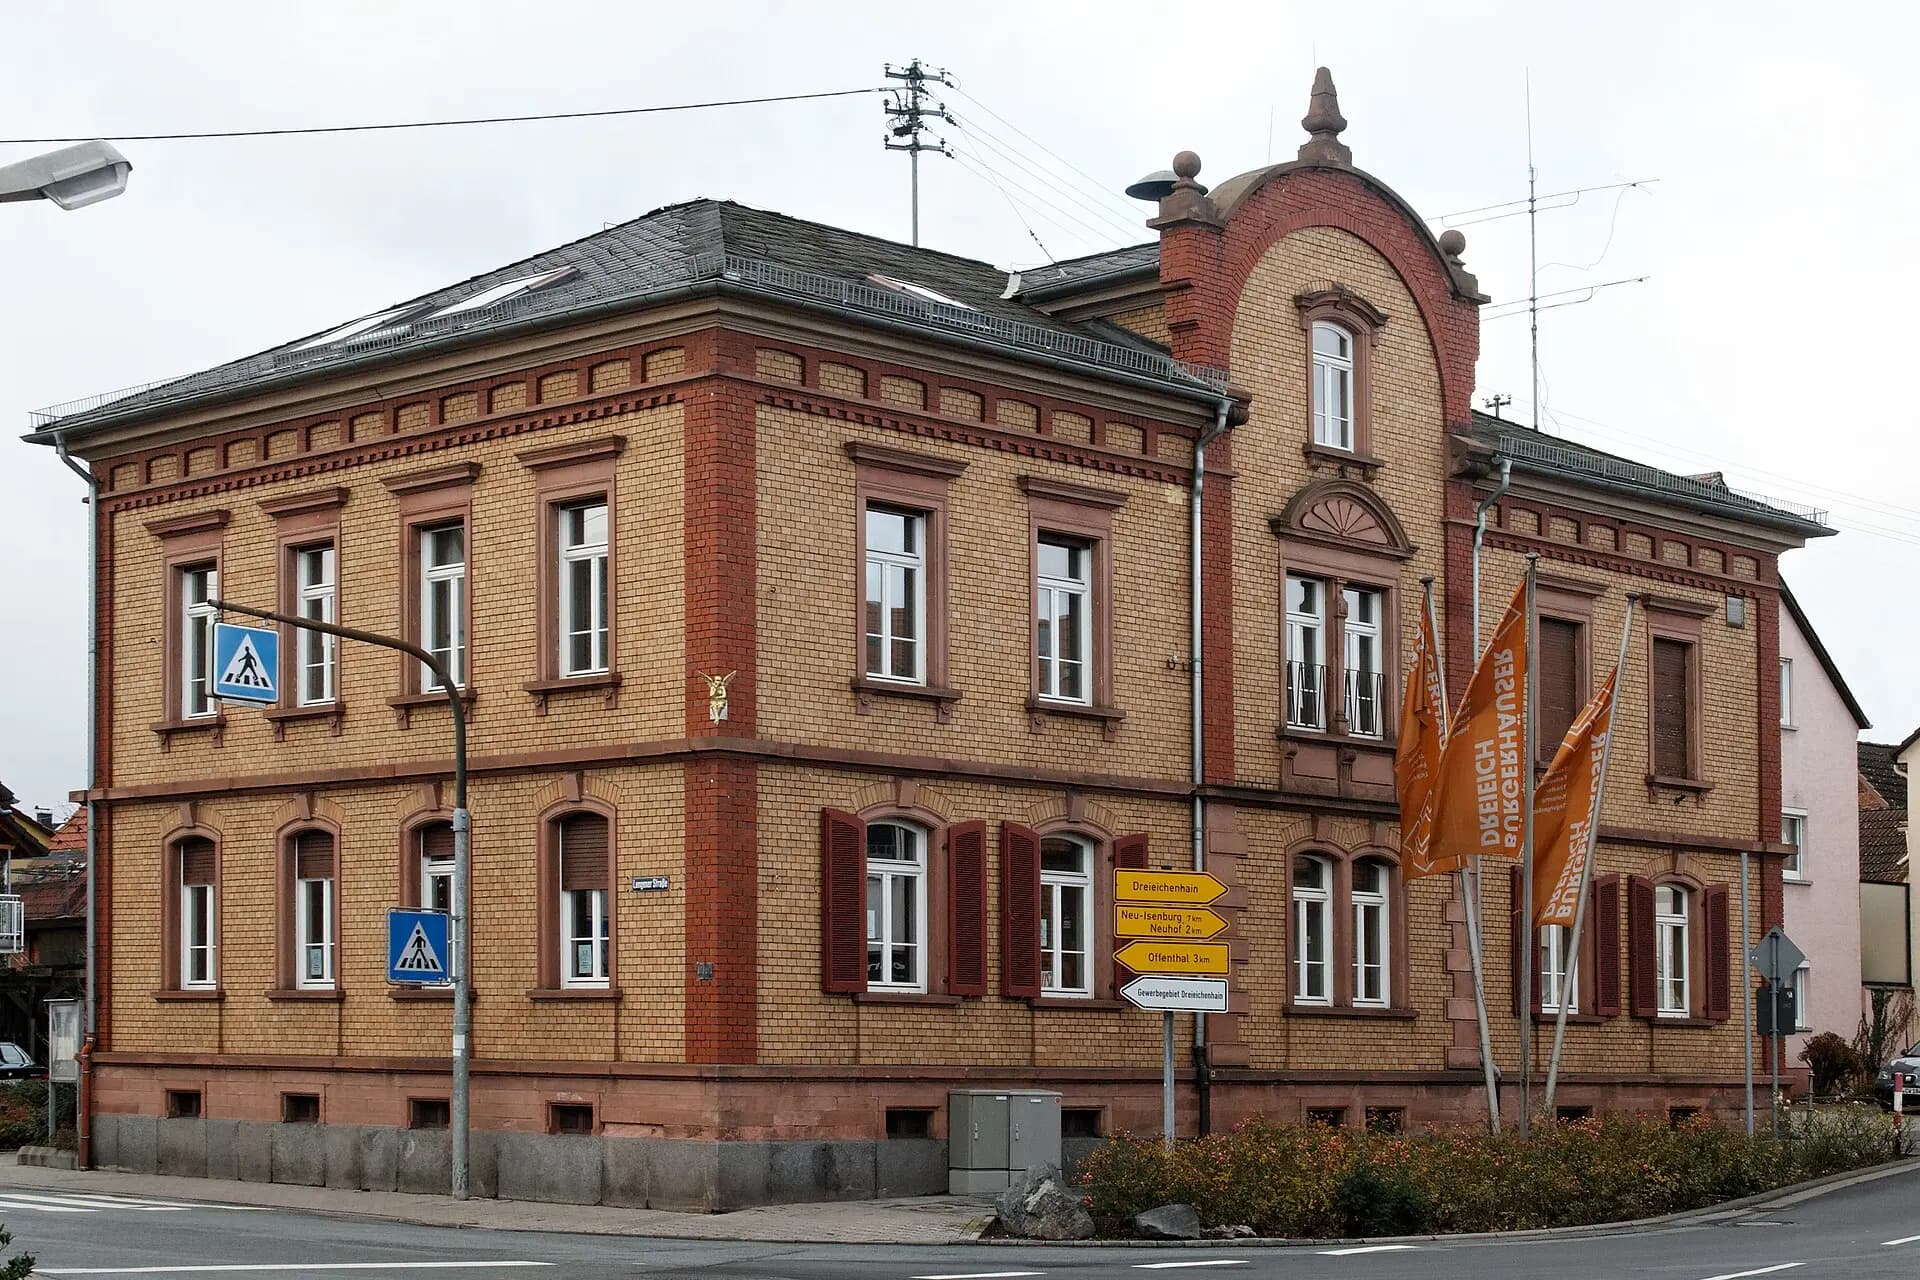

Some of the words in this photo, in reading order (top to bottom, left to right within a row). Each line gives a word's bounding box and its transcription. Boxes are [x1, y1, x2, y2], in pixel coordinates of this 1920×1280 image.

[1132, 881, 1199, 894] Dreieichenhain
[1121, 910, 1182, 924] Neu-Isenburg
[1150, 924, 1182, 934] Neuhof
[1148, 952, 1189, 963] Offenthal
[1137, 988, 1180, 1000] Gewerbegebiet
[1181, 990, 1224, 1000] Dreieichenhain
